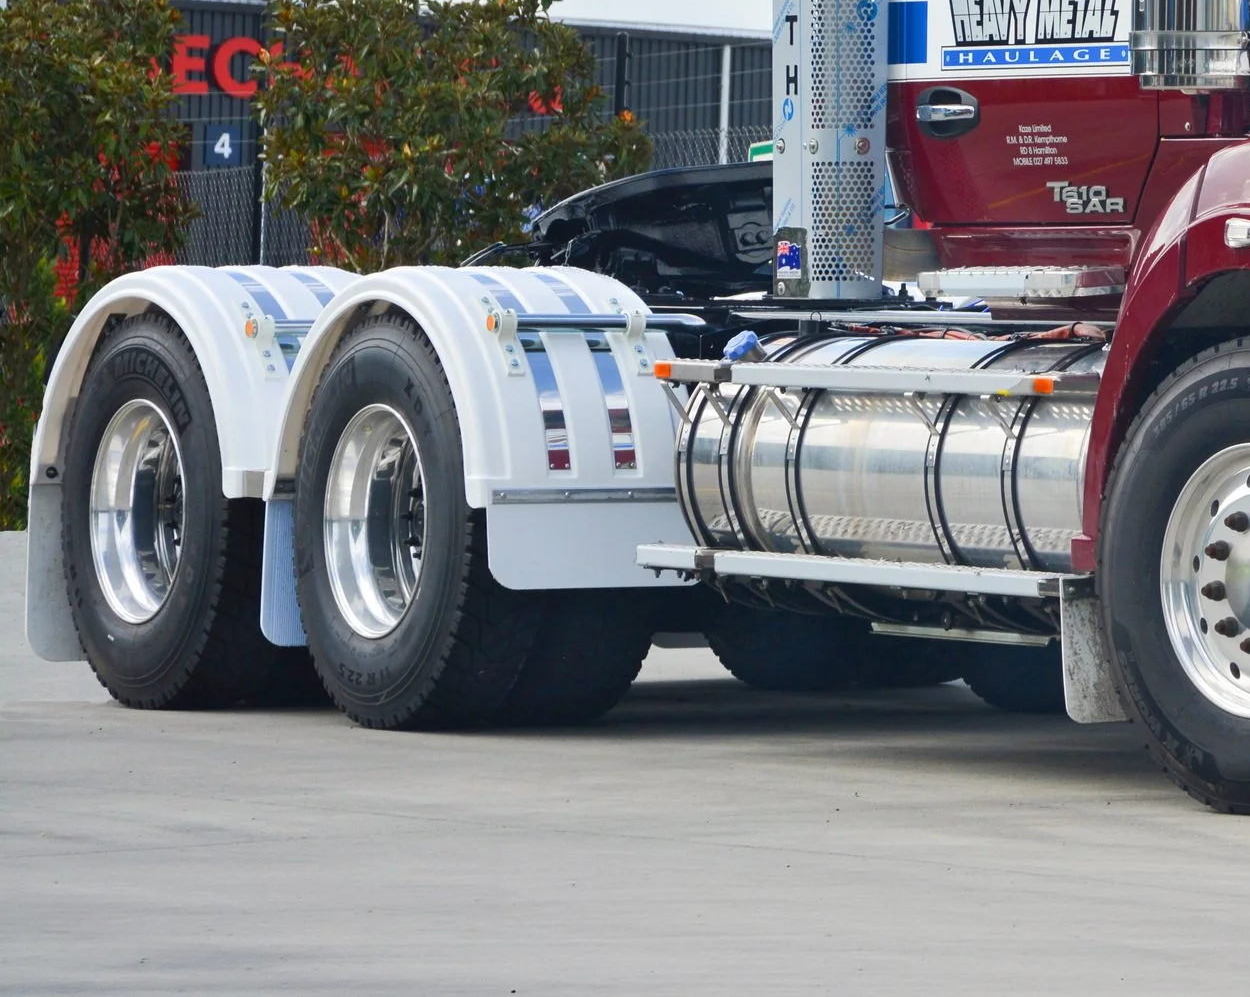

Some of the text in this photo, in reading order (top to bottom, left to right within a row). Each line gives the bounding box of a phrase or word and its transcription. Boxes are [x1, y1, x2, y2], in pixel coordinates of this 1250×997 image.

[958, 48, 1111, 64] HAULAGE
[1032, 124, 1051, 133] Limited
[214, 132, 232, 159] 4
[1033, 145, 1058, 155] Hamilton
[1013, 157, 1033, 166] MOBILE
[1046, 181, 1106, 202] T610
[1066, 198, 1124, 213] SAR
